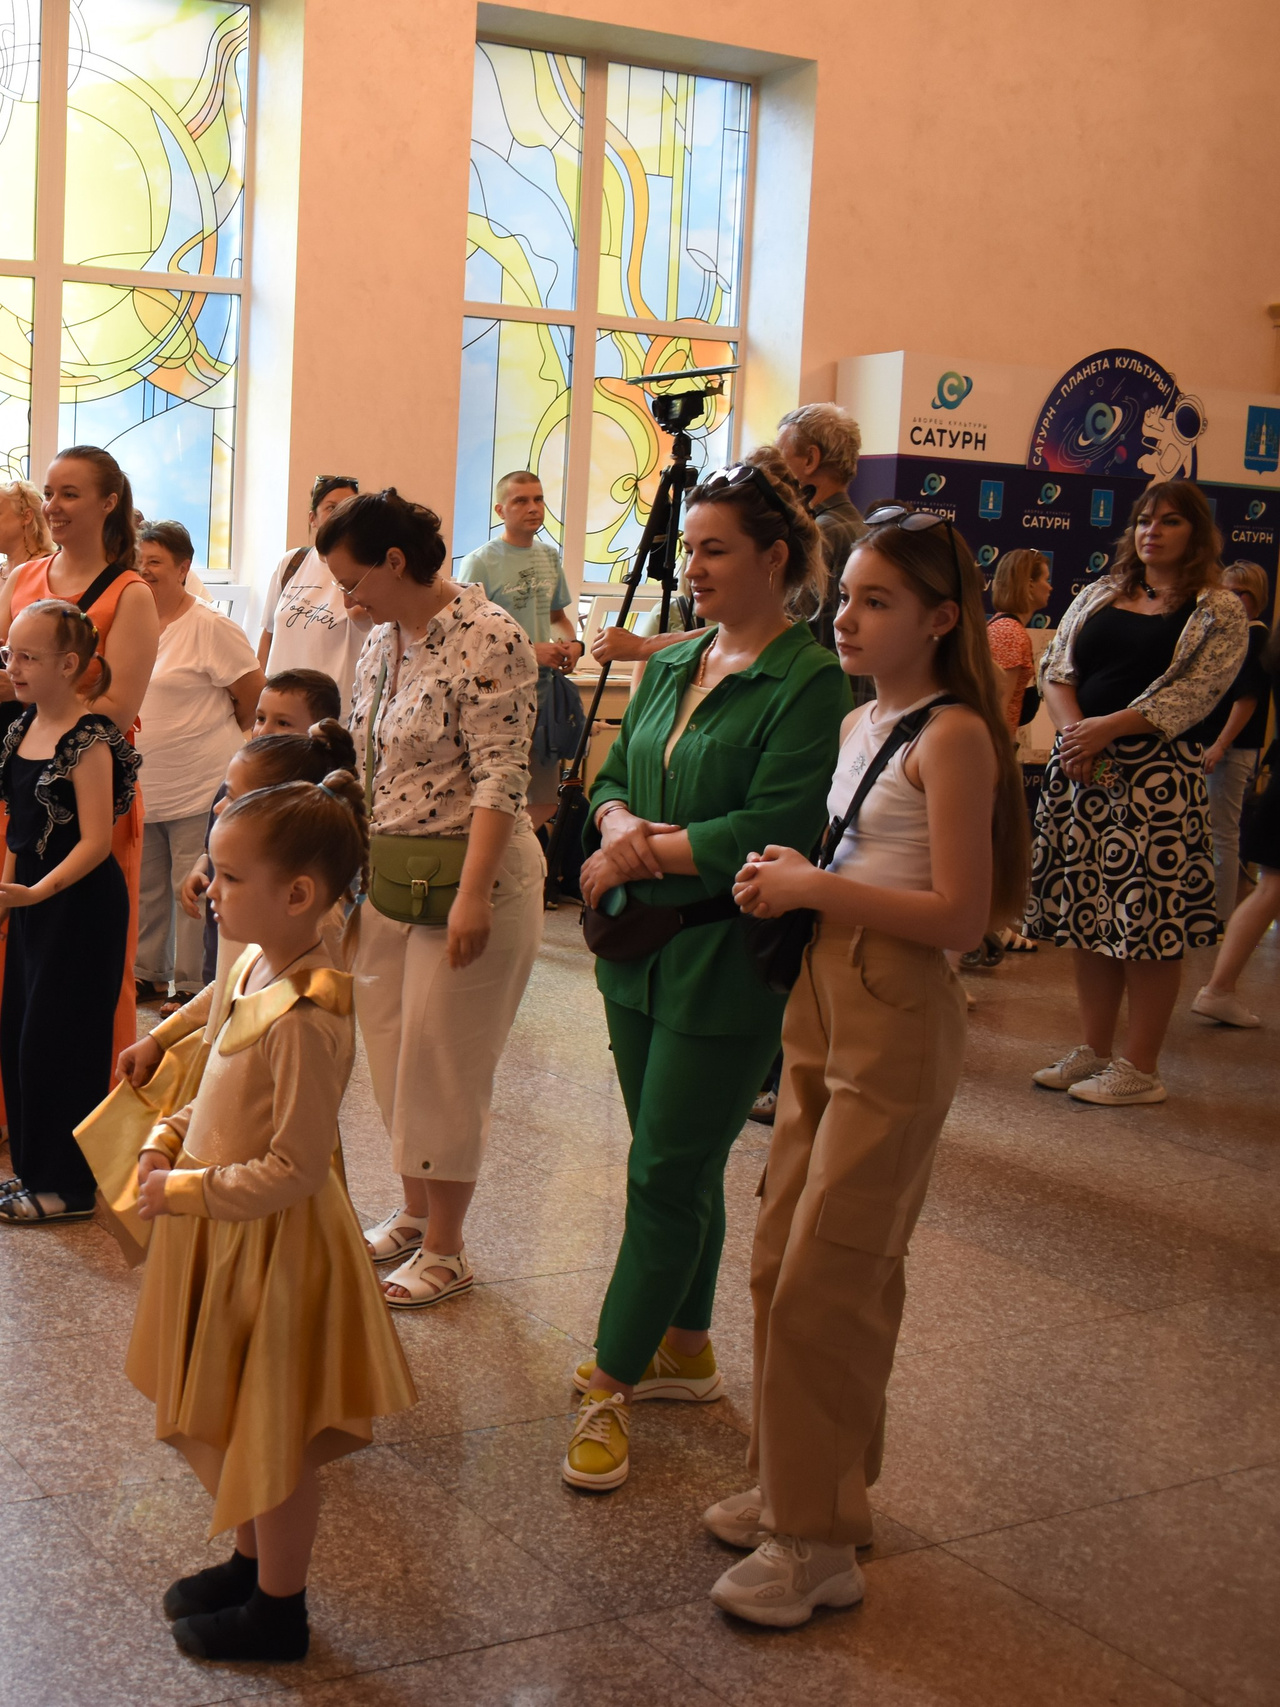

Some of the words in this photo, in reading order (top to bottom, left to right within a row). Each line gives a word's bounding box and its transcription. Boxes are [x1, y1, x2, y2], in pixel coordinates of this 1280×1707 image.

[1032, 407, 1057, 466] САТУРН
[1060, 357, 1110, 398] ПЛАНЕТА
[1115, 356, 1171, 397] КУЛЬТУРЫ!
[912, 416, 944, 426] ДВОРЕЦ
[948, 420, 988, 430] КУЛЬТУРЫ
[910, 426, 987, 451] САТУРН
[1022, 514, 1071, 530] САТУРН
[1231, 529, 1274, 544] САТУРН
[281, 585, 338, 630] Together
